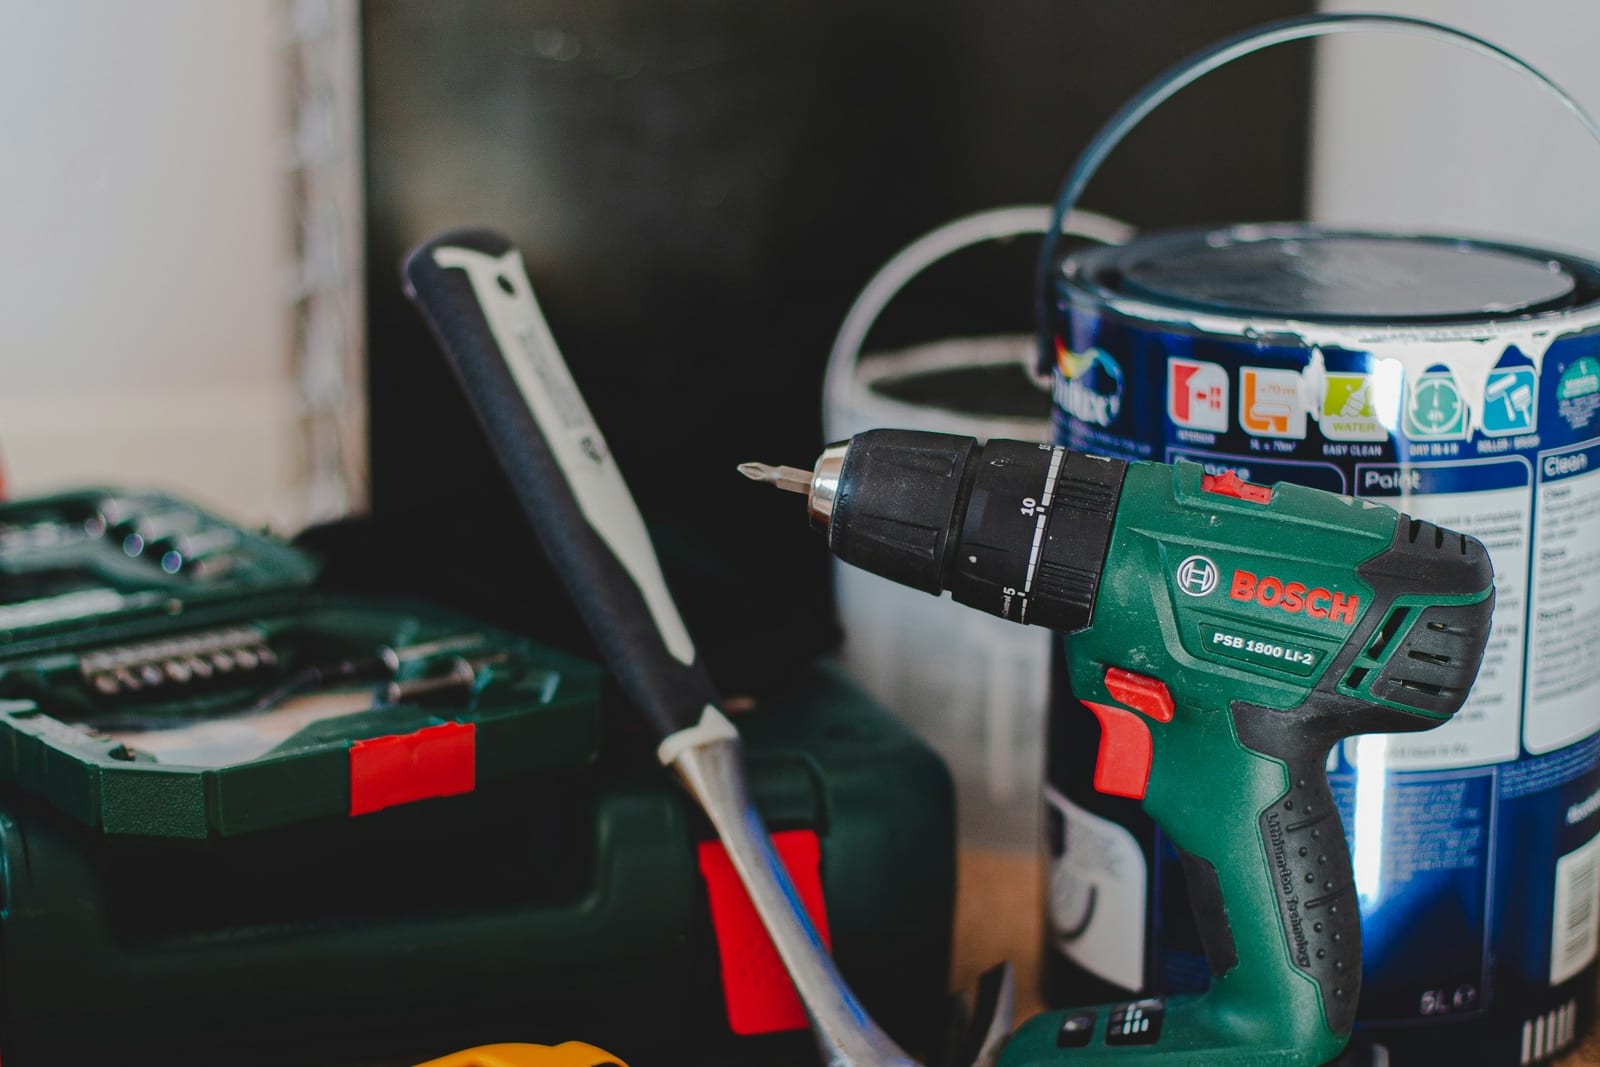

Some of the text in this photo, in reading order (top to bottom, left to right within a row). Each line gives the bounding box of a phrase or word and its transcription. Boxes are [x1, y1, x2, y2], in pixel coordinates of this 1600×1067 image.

[1333, 422, 1375, 432] WATER
[1323, 444, 1382, 457] EASY CLEAN
[1409, 443, 1430, 456] DRY
[1544, 453, 1588, 477] Clean
[1365, 470, 1421, 489] Paint
[1020, 497, 1036, 517] 10
[1003, 586, 1015, 596] 5
[1230, 570, 1359, 624] BOSCH
[1213, 632, 1315, 665] PSB 1800 LI-2
[1287, 896, 1311, 967] Technology
